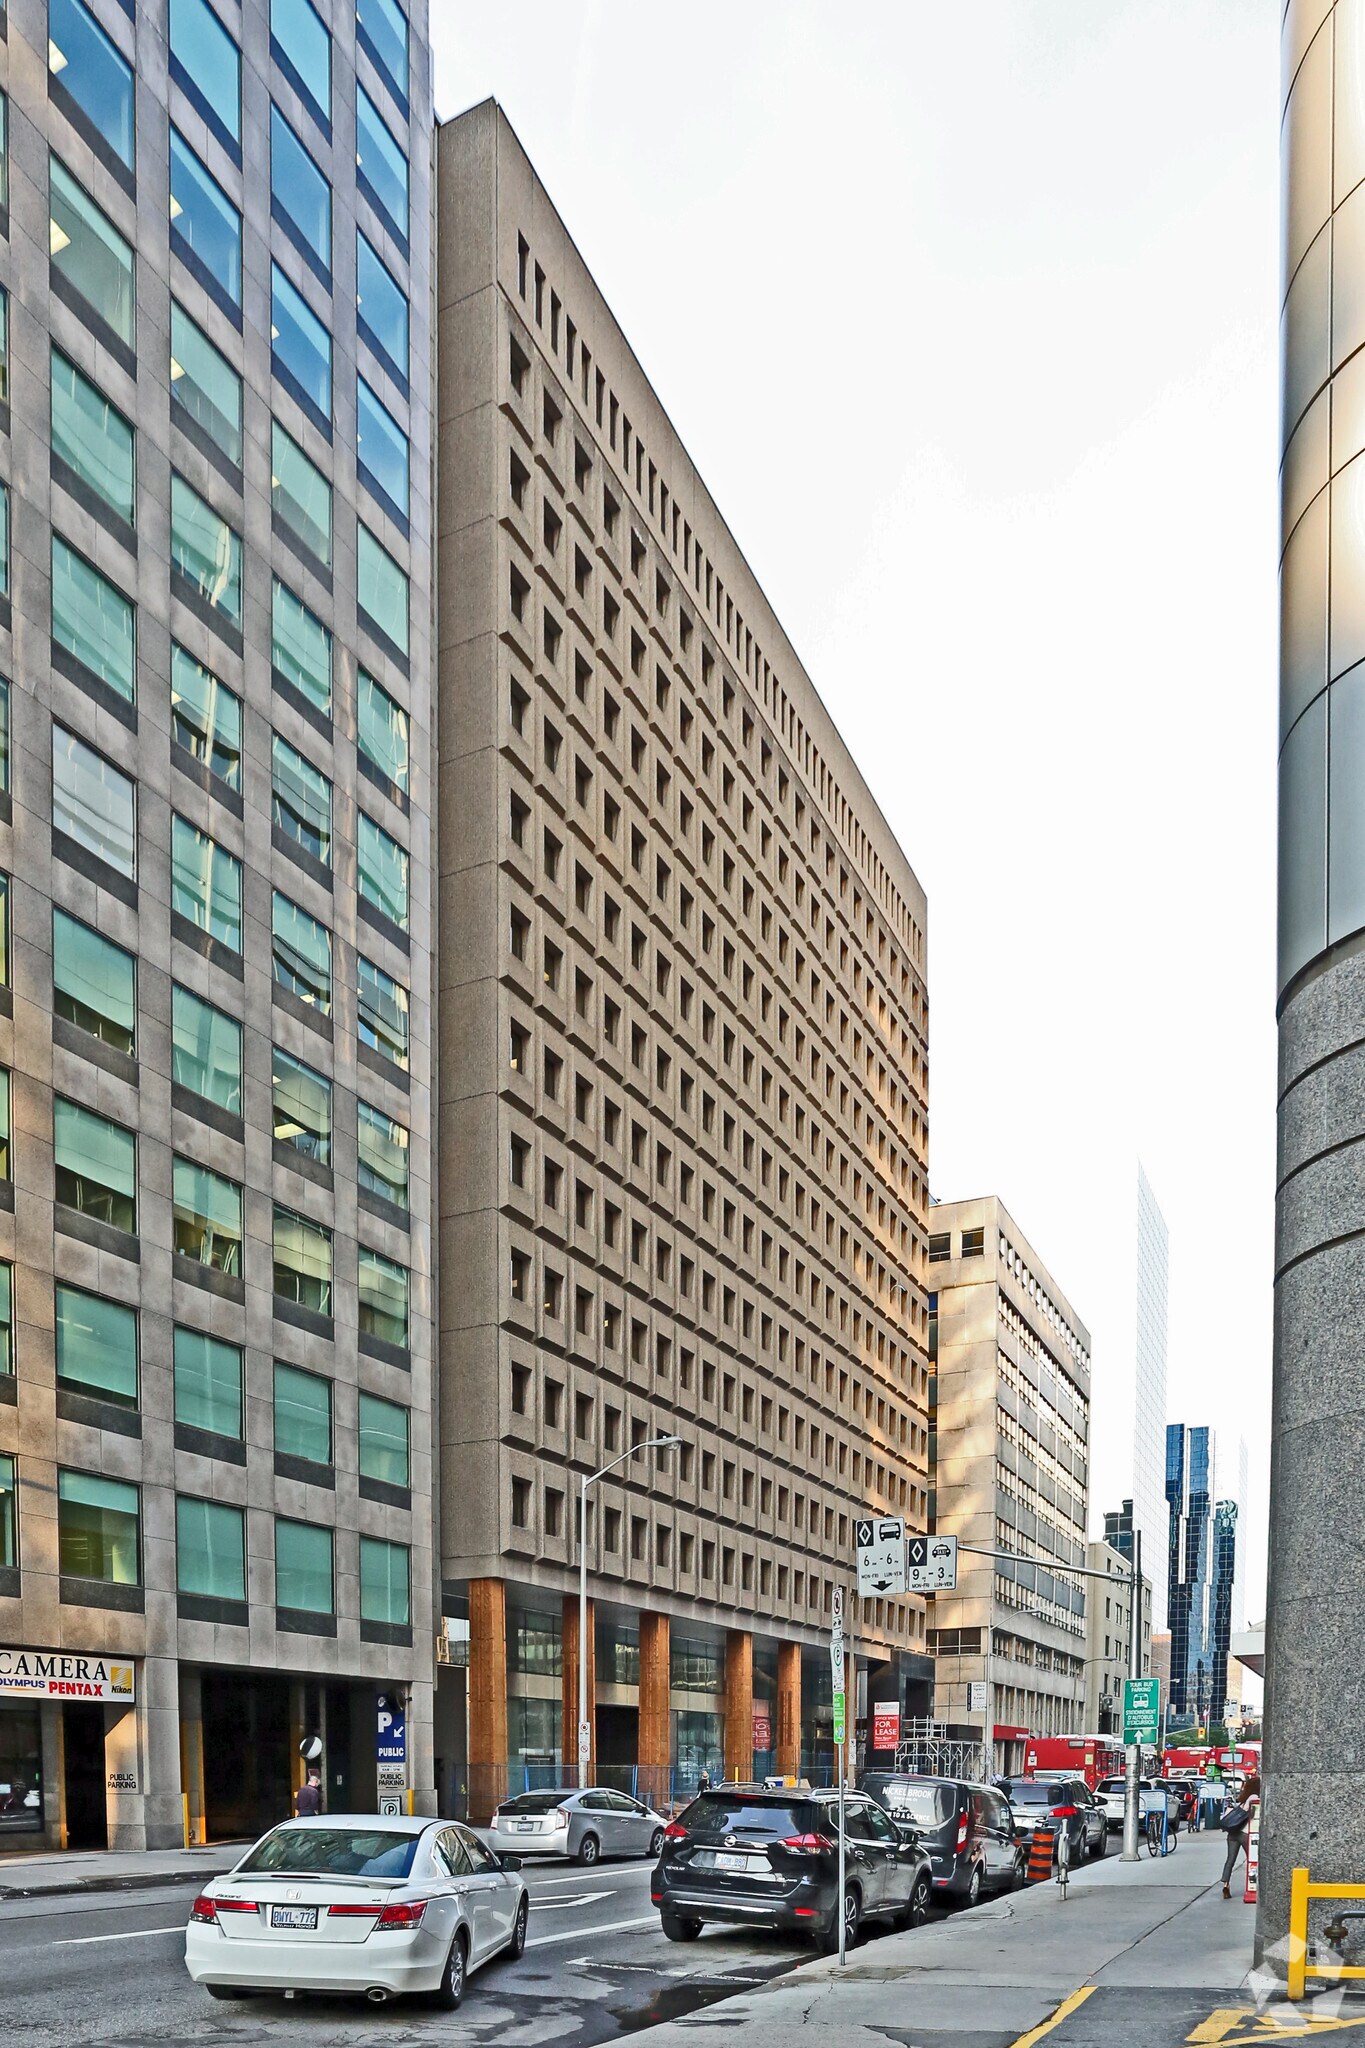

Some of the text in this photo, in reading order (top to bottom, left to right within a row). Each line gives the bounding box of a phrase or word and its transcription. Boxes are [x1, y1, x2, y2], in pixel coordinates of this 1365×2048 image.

[863, 1555, 870, 1567] 6
[886, 1553, 892, 1565] 6
[912, 1568, 920, 1580] 9
[937, 1567, 945, 1579] 3
[0, 1652, 108, 1681] CAMERA
[49, 1681, 103, 1697] PENTAX
[111, 1685, 132, 1694] Nikon
[377, 1712, 393, 1733] P
[875, 1728, 897, 1736] LEASE
[378, 1747, 404, 1757] PUBLIC
[109, 1773, 134, 1781] PUBLIC
[107, 1781, 137, 1789] PARKING
[882, 1786, 933, 1799] NICKEL BROOK
[906, 1813, 931, 1821] SCIENCE
[300, 1912, 316, 1923] 772
